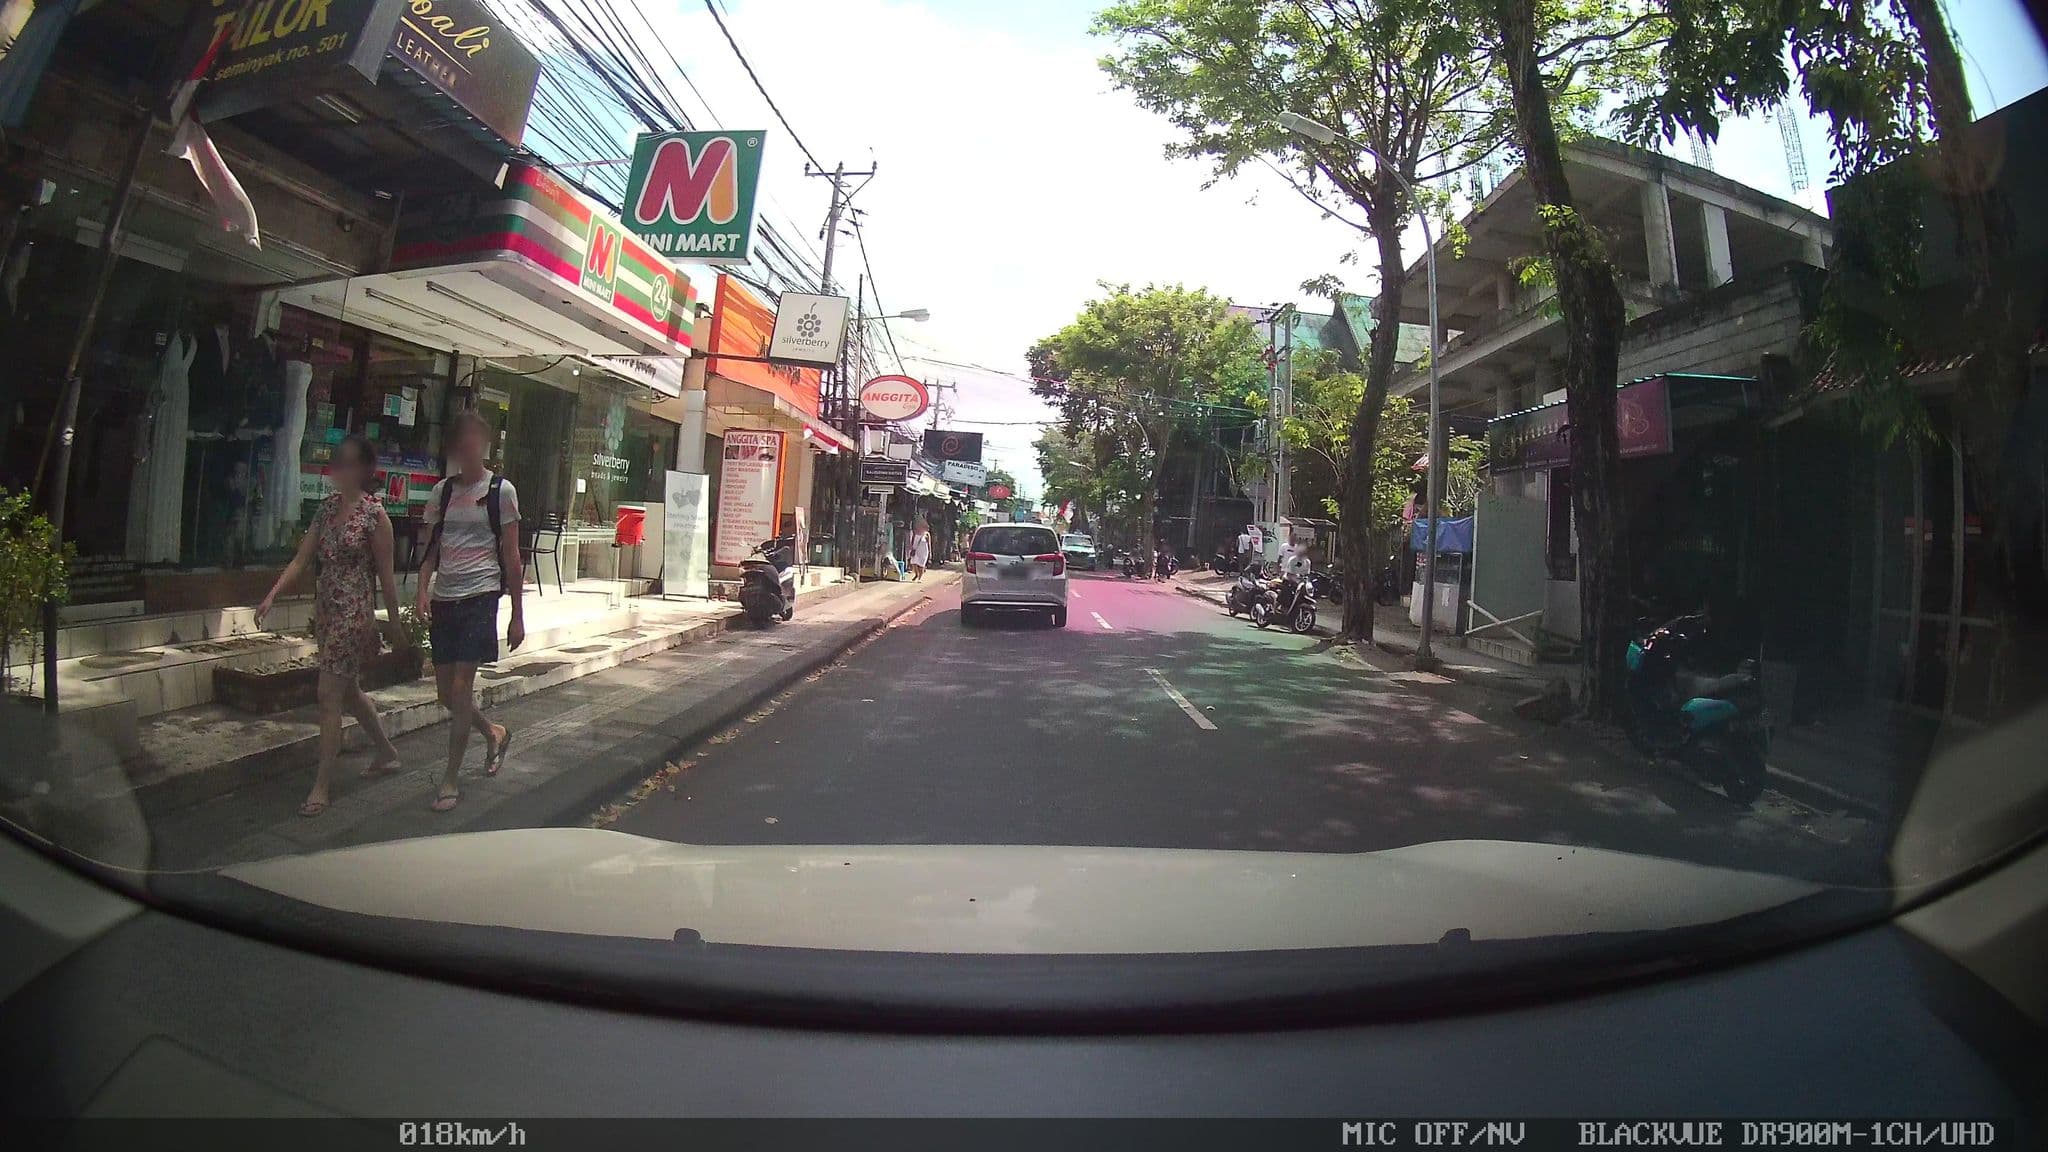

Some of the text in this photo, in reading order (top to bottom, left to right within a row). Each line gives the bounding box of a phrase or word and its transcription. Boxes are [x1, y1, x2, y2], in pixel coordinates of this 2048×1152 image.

[316, 31, 348, 54] 501
[675, 233, 741, 252] MART
[655, 280, 667, 305] 24
[781, 336, 830, 349] silverberry
[863, 392, 919, 402] ANGGITA
[726, 434, 777, 446] ANGGITA SPA
